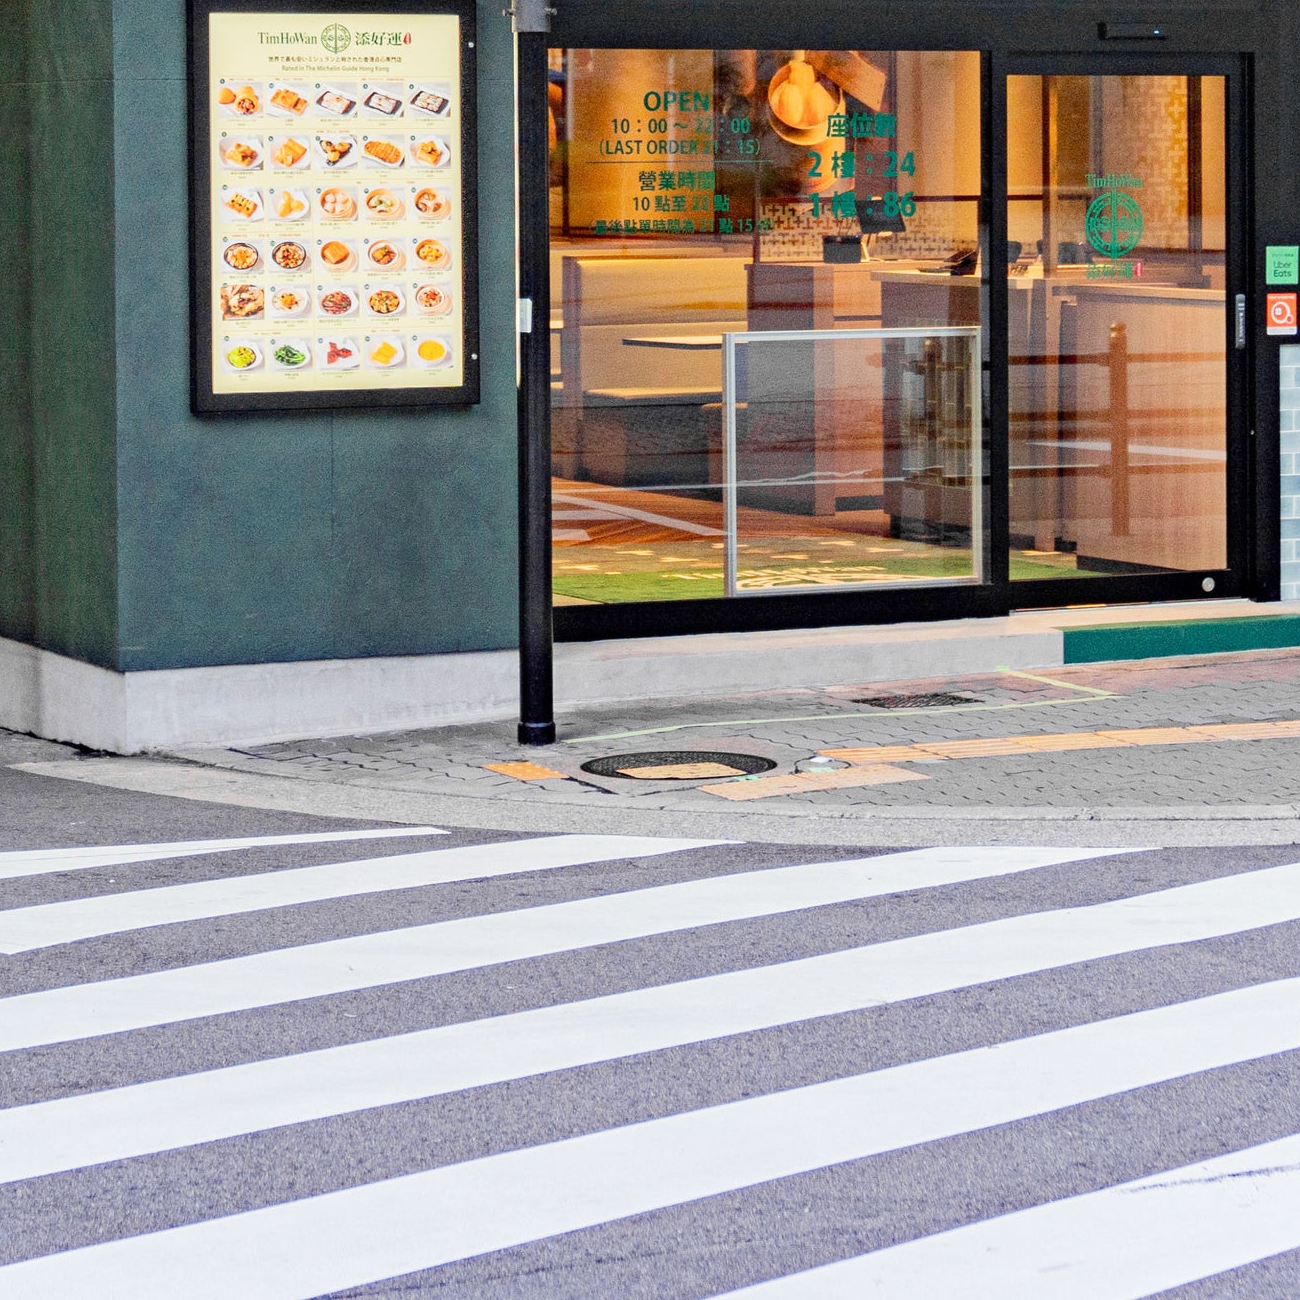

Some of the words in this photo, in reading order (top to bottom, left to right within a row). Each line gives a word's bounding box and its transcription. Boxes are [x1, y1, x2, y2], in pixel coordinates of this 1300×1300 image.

[258, 31, 318, 45] TimHoWan
[355, 31, 402, 46] 添好運
[643, 91, 710, 112] OPEN
[646, 140, 699, 155] ORDER
[807, 151, 822, 177] 2
[808, 192, 820, 219] 1
[1273, 261, 1292, 269] Uber
[1273, 270, 1292, 278] Eats
